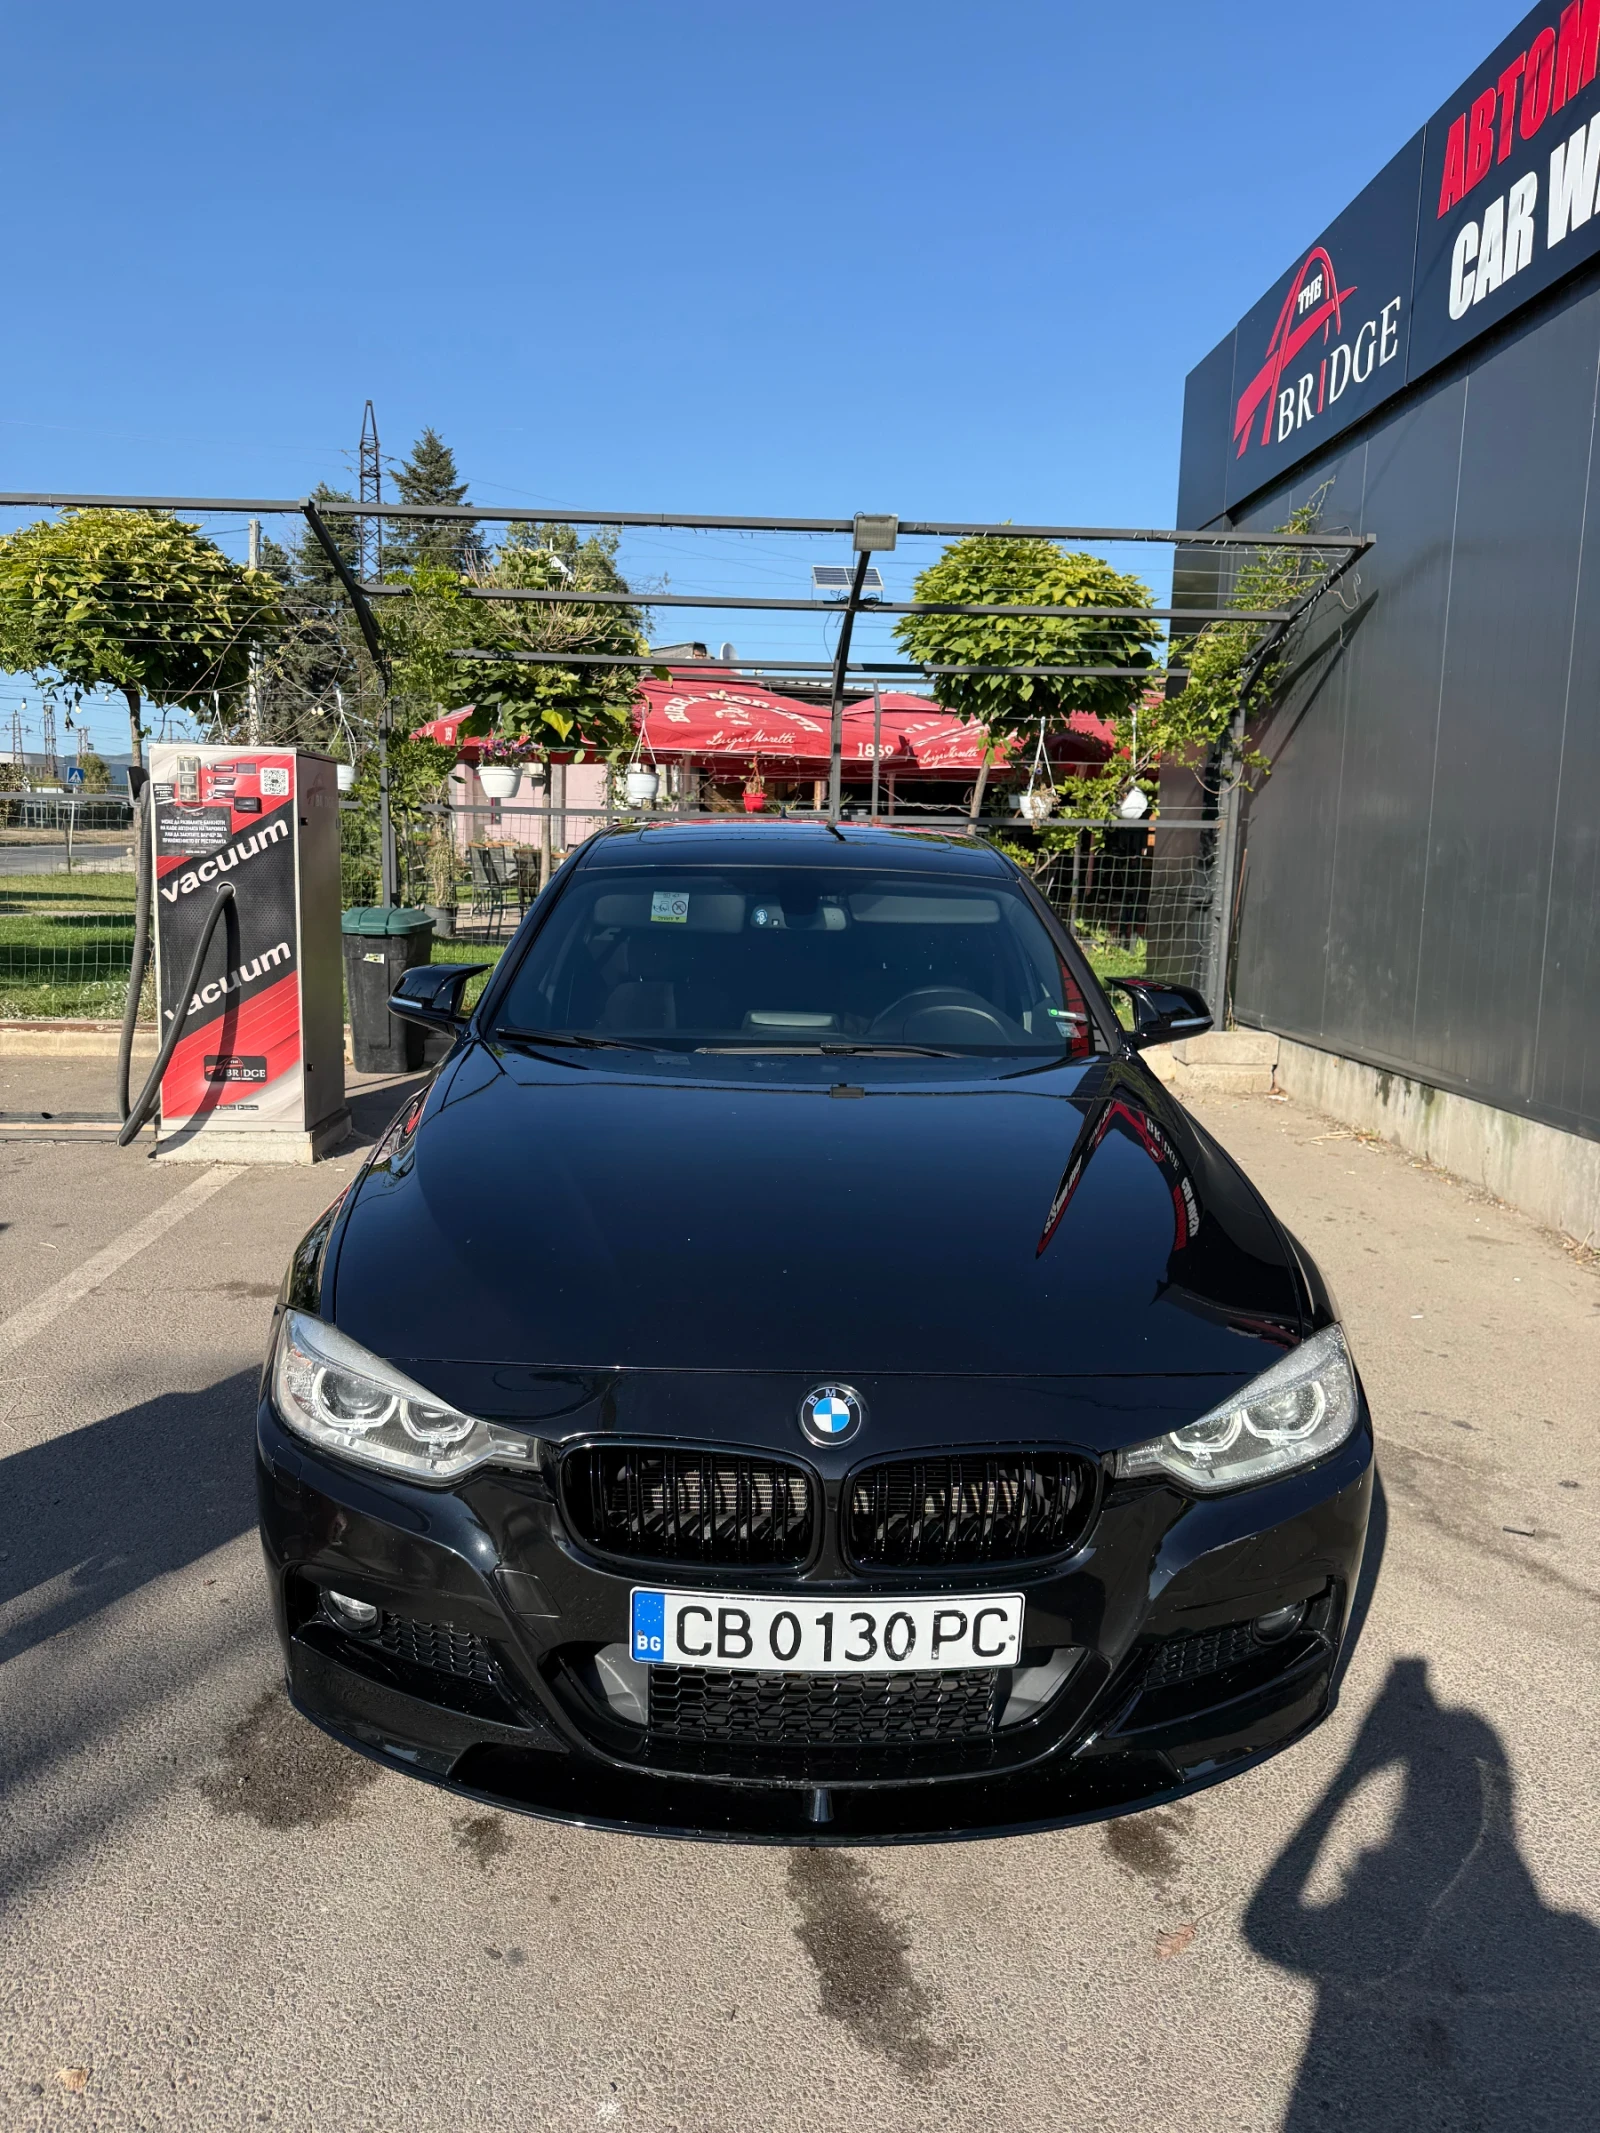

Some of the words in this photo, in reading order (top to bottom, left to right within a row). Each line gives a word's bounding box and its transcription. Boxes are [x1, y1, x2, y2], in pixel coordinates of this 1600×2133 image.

[1437, 0, 1600, 219] АВТОМ
[1449, 171, 1538, 320] CAR
[1547, 110, 1600, 250] W
[1297, 273, 1323, 315] THE
[1277, 295, 1401, 443] BRIDGE
[664, 693, 707, 723] BIRRA
[706, 730, 746, 751] Luigi
[746, 729, 797, 745] Moretti
[160, 819, 289, 903] vacuum
[226, 1069, 266, 1078] BRIDGE
[806, 1388, 856, 1407] BMW
[636, 1635, 661, 1653] BG
[675, 1605, 753, 1659] CB
[769, 1611, 917, 1662] 0130
[931, 1607, 1008, 1661] PC
